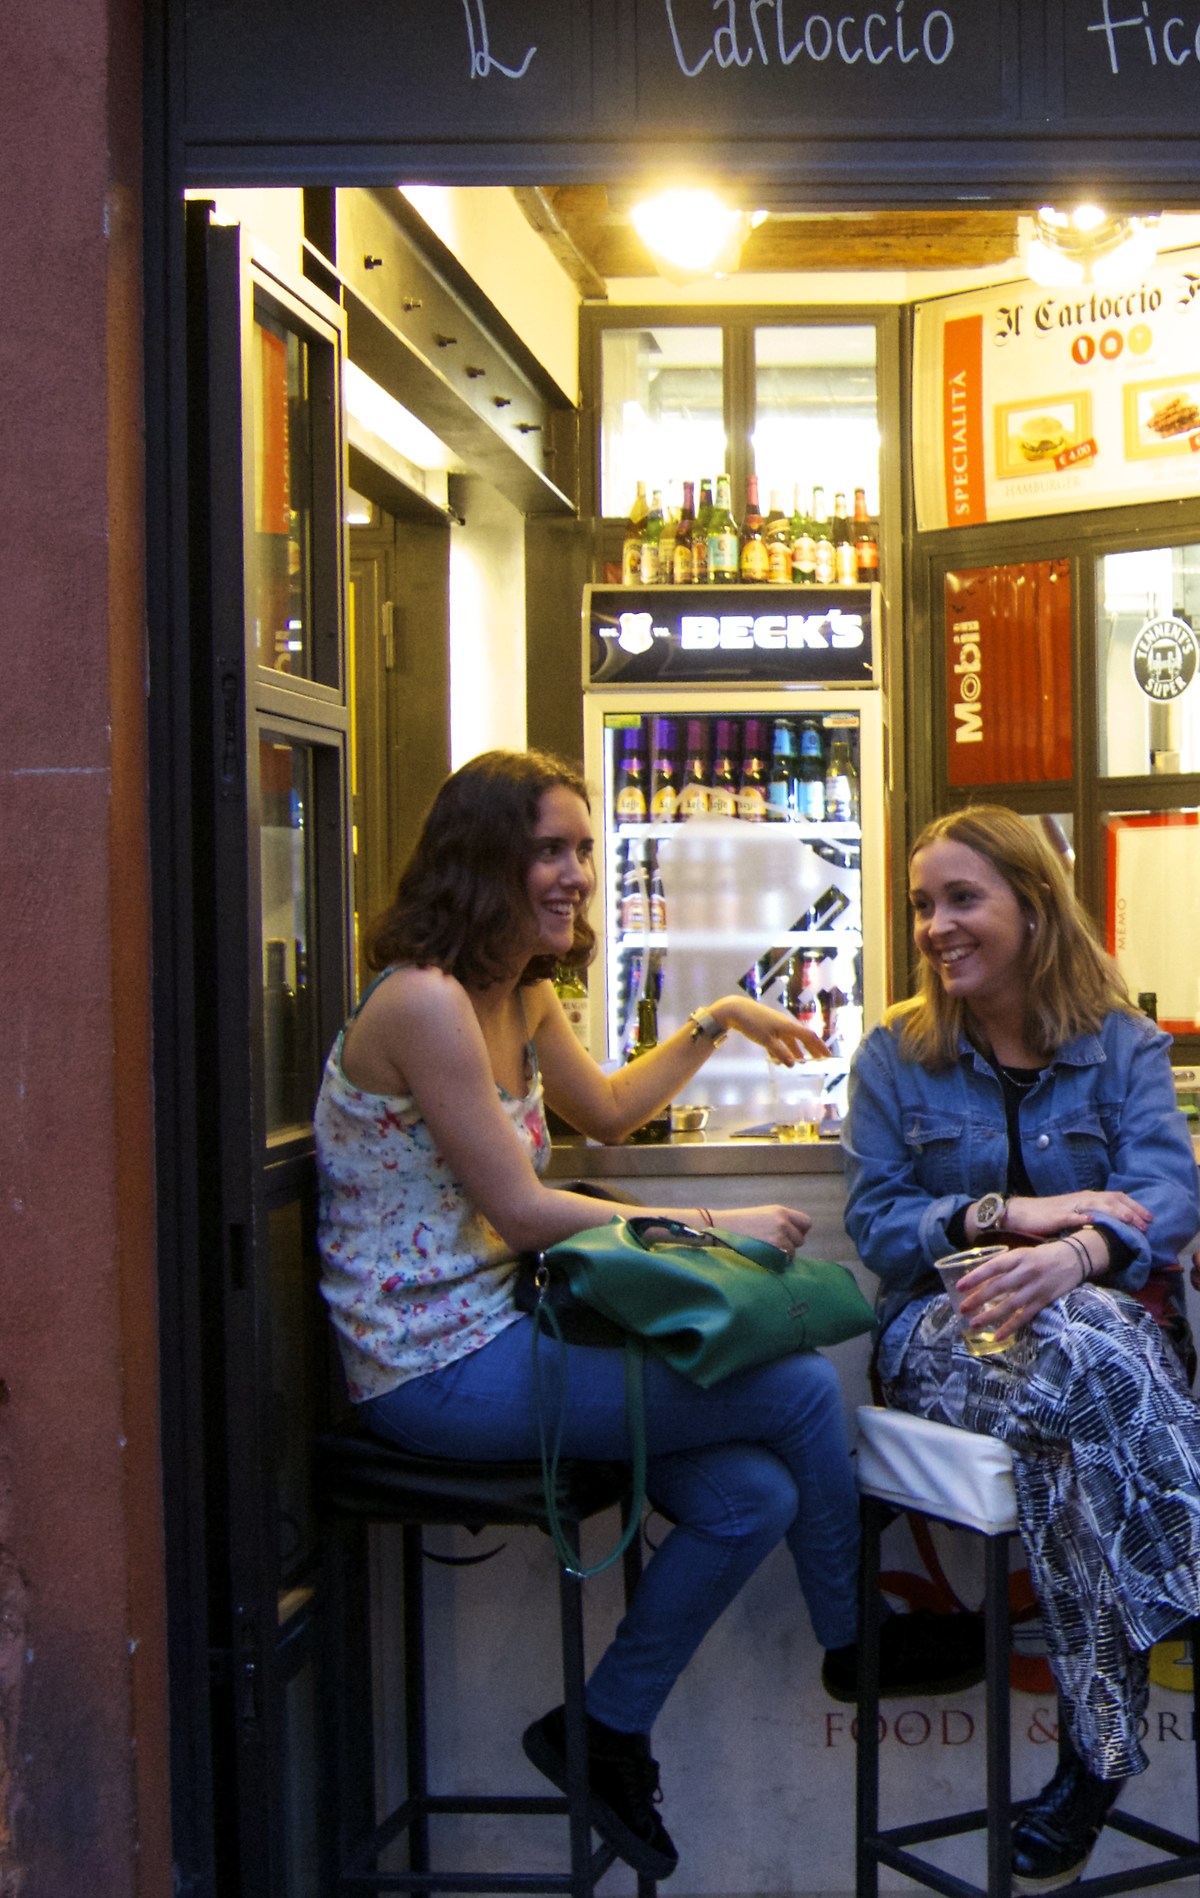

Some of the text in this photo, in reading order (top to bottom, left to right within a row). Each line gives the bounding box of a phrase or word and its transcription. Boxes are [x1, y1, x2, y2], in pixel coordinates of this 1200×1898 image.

[1034, 285, 1162, 339] Cartoccio
[949, 370, 970, 516] SPECIALITÀ
[1068, 443, 1092, 461] 4.00
[681, 608, 864, 650] BECK'S
[1136, 621, 1195, 659] TENNENT'S
[953, 620, 983, 743] Mobil
[1144, 675, 1187, 699] SUPER
[1027, 1708, 1060, 1744] &
